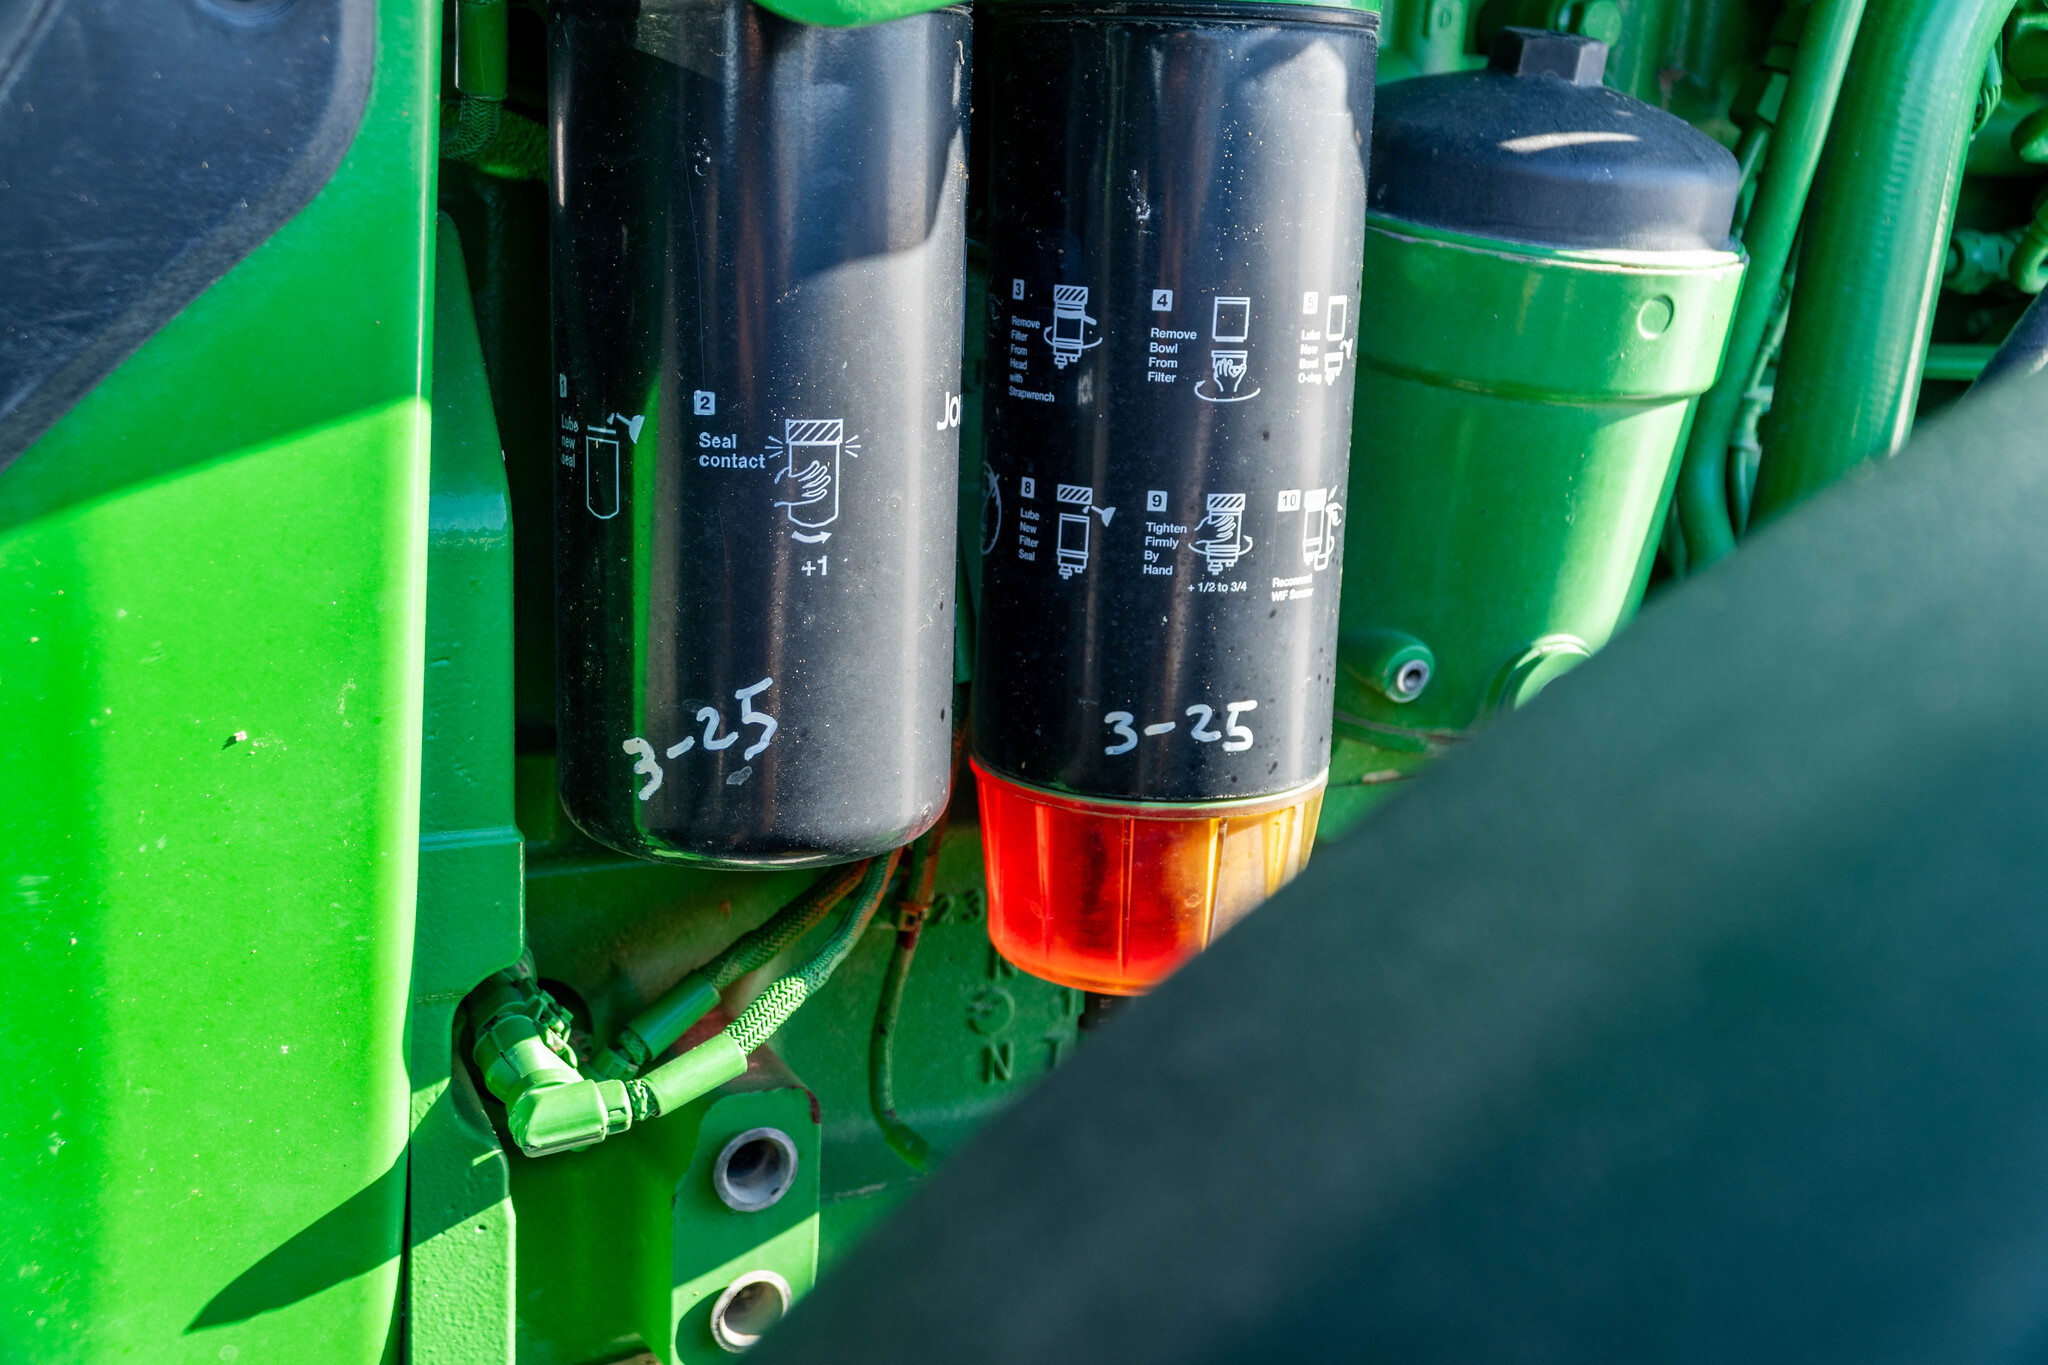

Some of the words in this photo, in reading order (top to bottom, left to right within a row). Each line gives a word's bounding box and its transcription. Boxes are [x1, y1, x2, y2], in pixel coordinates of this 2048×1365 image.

[1011, 315, 1040, 329] Remove
[1011, 329, 1028, 341] Filter
[1150, 327, 1197, 340] Remove
[1010, 343, 1028, 356] From
[1149, 342, 1178, 354] Bowl
[1010, 358, 1028, 370] Head
[1148, 356, 1178, 368] From
[1009, 372, 1023, 383] with
[1147, 371, 1177, 383] Filter
[1008, 385, 1055, 403] Strapwrench
[561, 414, 579, 433] Lube
[561, 435, 576, 449] new
[699, 431, 737, 449] Seal
[561, 453, 576, 468] seal
[699, 453, 766, 469] contact
[1281, 493, 1298, 509] 10
[1020, 507, 1040, 521] Lube
[1019, 521, 1037, 534] New
[1145, 521, 1188, 535] Tighten
[1019, 535, 1039, 548] Filter
[1144, 536, 1179, 550] Firmly
[1018, 548, 1036, 561] Seal
[1144, 550, 1160, 563] By
[801, 555, 828, 576] +1
[1143, 564, 1173, 576] Hand
[1198, 582, 1216, 593] 1/2
[1217, 583, 1229, 592] to
[1230, 581, 1248, 592] 3/4
[1104, 700, 1258, 756] 3-25
[622, 676, 778, 801] 3-25
